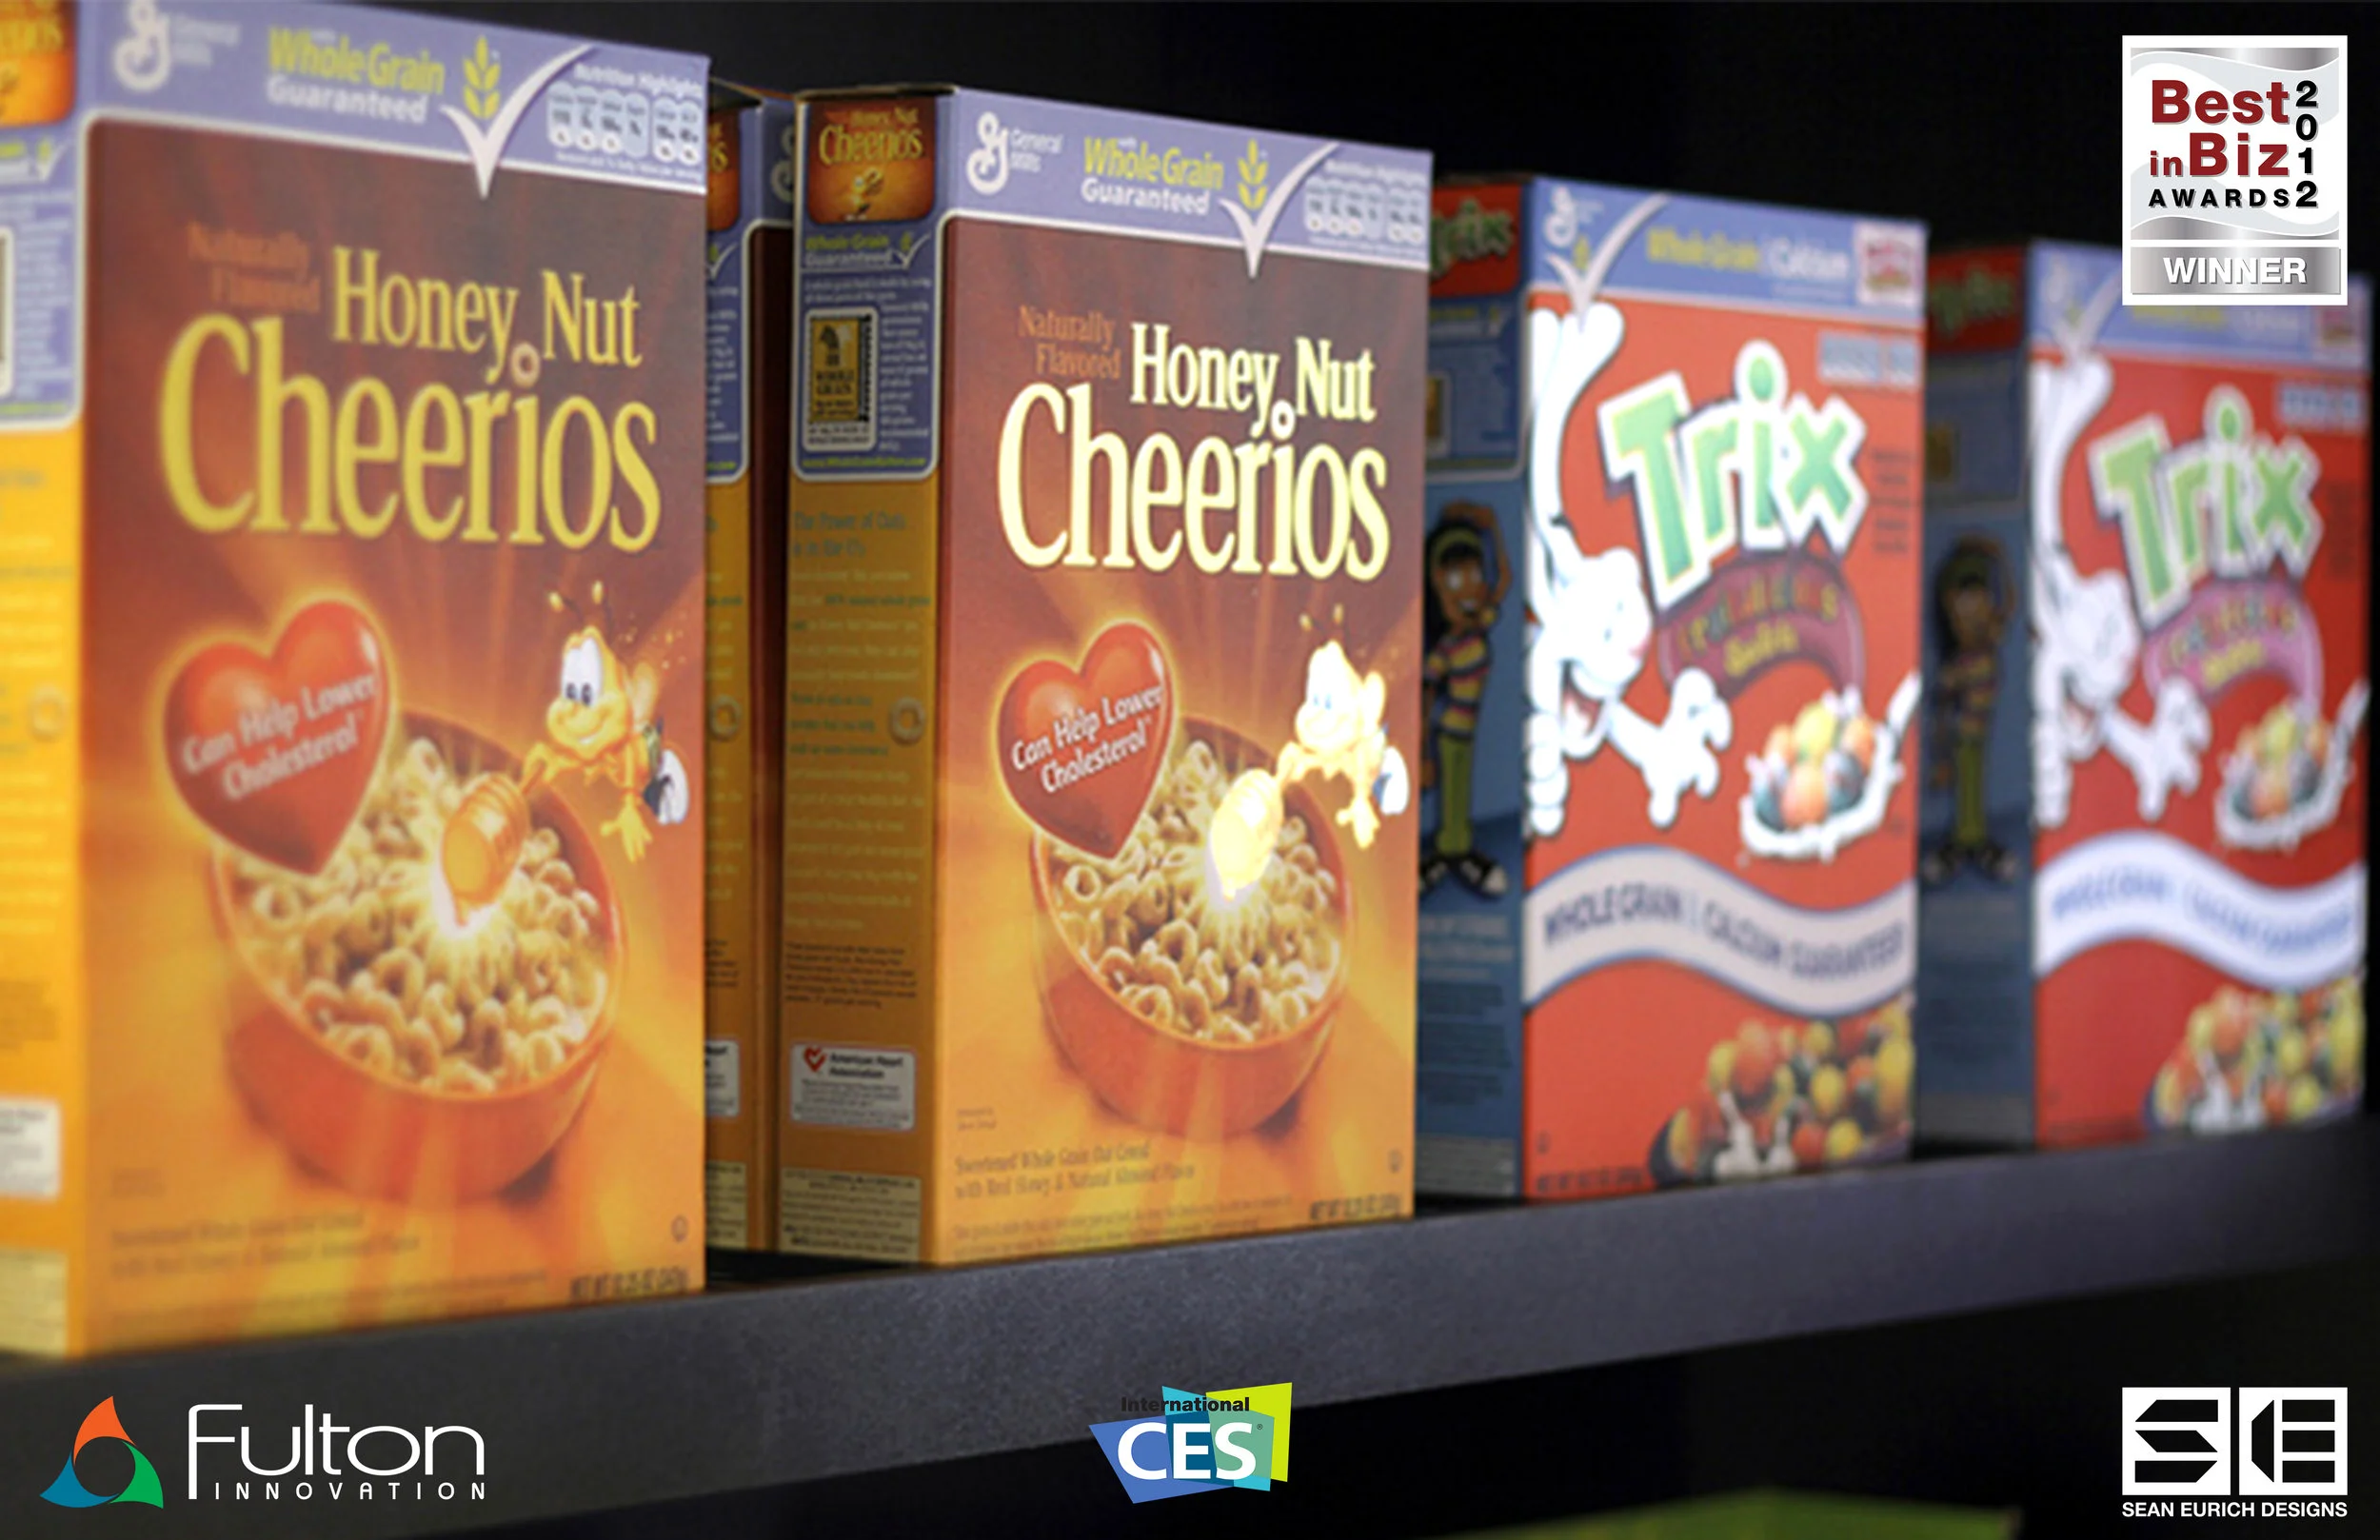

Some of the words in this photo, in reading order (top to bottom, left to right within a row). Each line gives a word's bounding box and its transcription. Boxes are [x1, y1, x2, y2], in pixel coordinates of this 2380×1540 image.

[267, 73, 426, 124] Guaranteed
[268, 27, 364, 82] Whole
[367, 42, 446, 94] Grain
[819, 125, 923, 166] Cheerios
[1084, 136, 1160, 182] Whole
[1161, 147, 1224, 190] Grain
[1081, 176, 1211, 216] Guaranteed
[331, 246, 520, 385] Honey
[541, 267, 644, 368] Nut
[1019, 306, 1117, 351] Naturally
[1036, 343, 1121, 380] Flavored
[1130, 322, 1280, 439] Honey
[1296, 336, 1378, 423] Nut
[160, 313, 662, 553] Cheerios
[998, 382, 1392, 582] Cheerios
[1597, 339, 1870, 614] Trix
[2087, 385, 2325, 636] Trix
[183, 732, 236, 775] Can
[239, 697, 300, 746] Help
[300, 674, 376, 721] Lower
[223, 712, 359, 800] Cholesterol
[1012, 736, 1053, 771] Can
[1053, 706, 1100, 749] Help
[1101, 685, 1163, 726] Lower
[1041, 718, 1146, 793] Cholesterol
[1544, 885, 1615, 946] WHOLE
[1619, 883, 1681, 920] GRAIN
